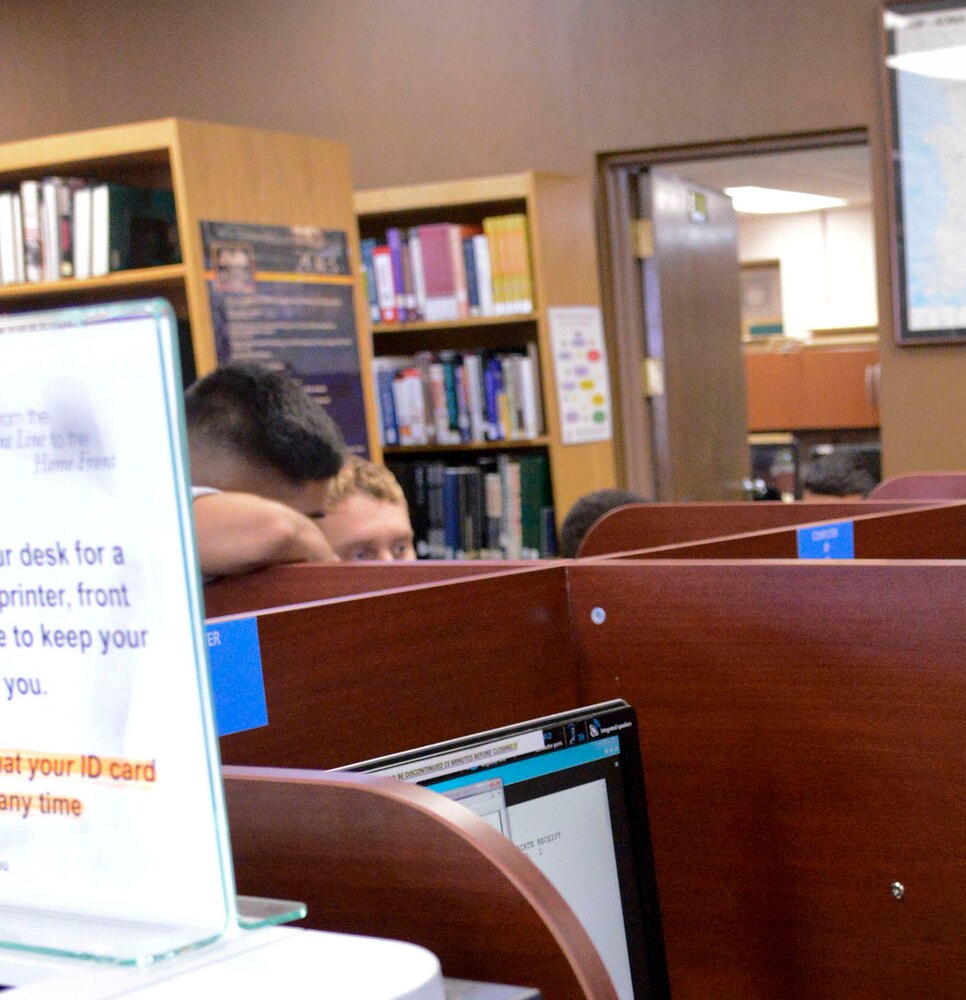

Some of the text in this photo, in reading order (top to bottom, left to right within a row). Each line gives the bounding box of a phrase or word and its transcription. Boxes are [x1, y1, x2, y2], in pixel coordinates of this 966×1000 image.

[34, 448, 117, 474] Home Front
[20, 541, 70, 567] desk
[76, 539, 104, 566] for
[112, 545, 125, 566] a
[0, 581, 131, 614] printer, front
[13, 625, 34, 648] to
[40, 622, 93, 654] keep
[98, 629, 149, 655] your
[3, 676, 47, 701] you.
[28, 756, 75, 781] your
[80, 755, 102, 778] ID
[109, 758, 156, 782] card
[0, 791, 82, 818] any time
